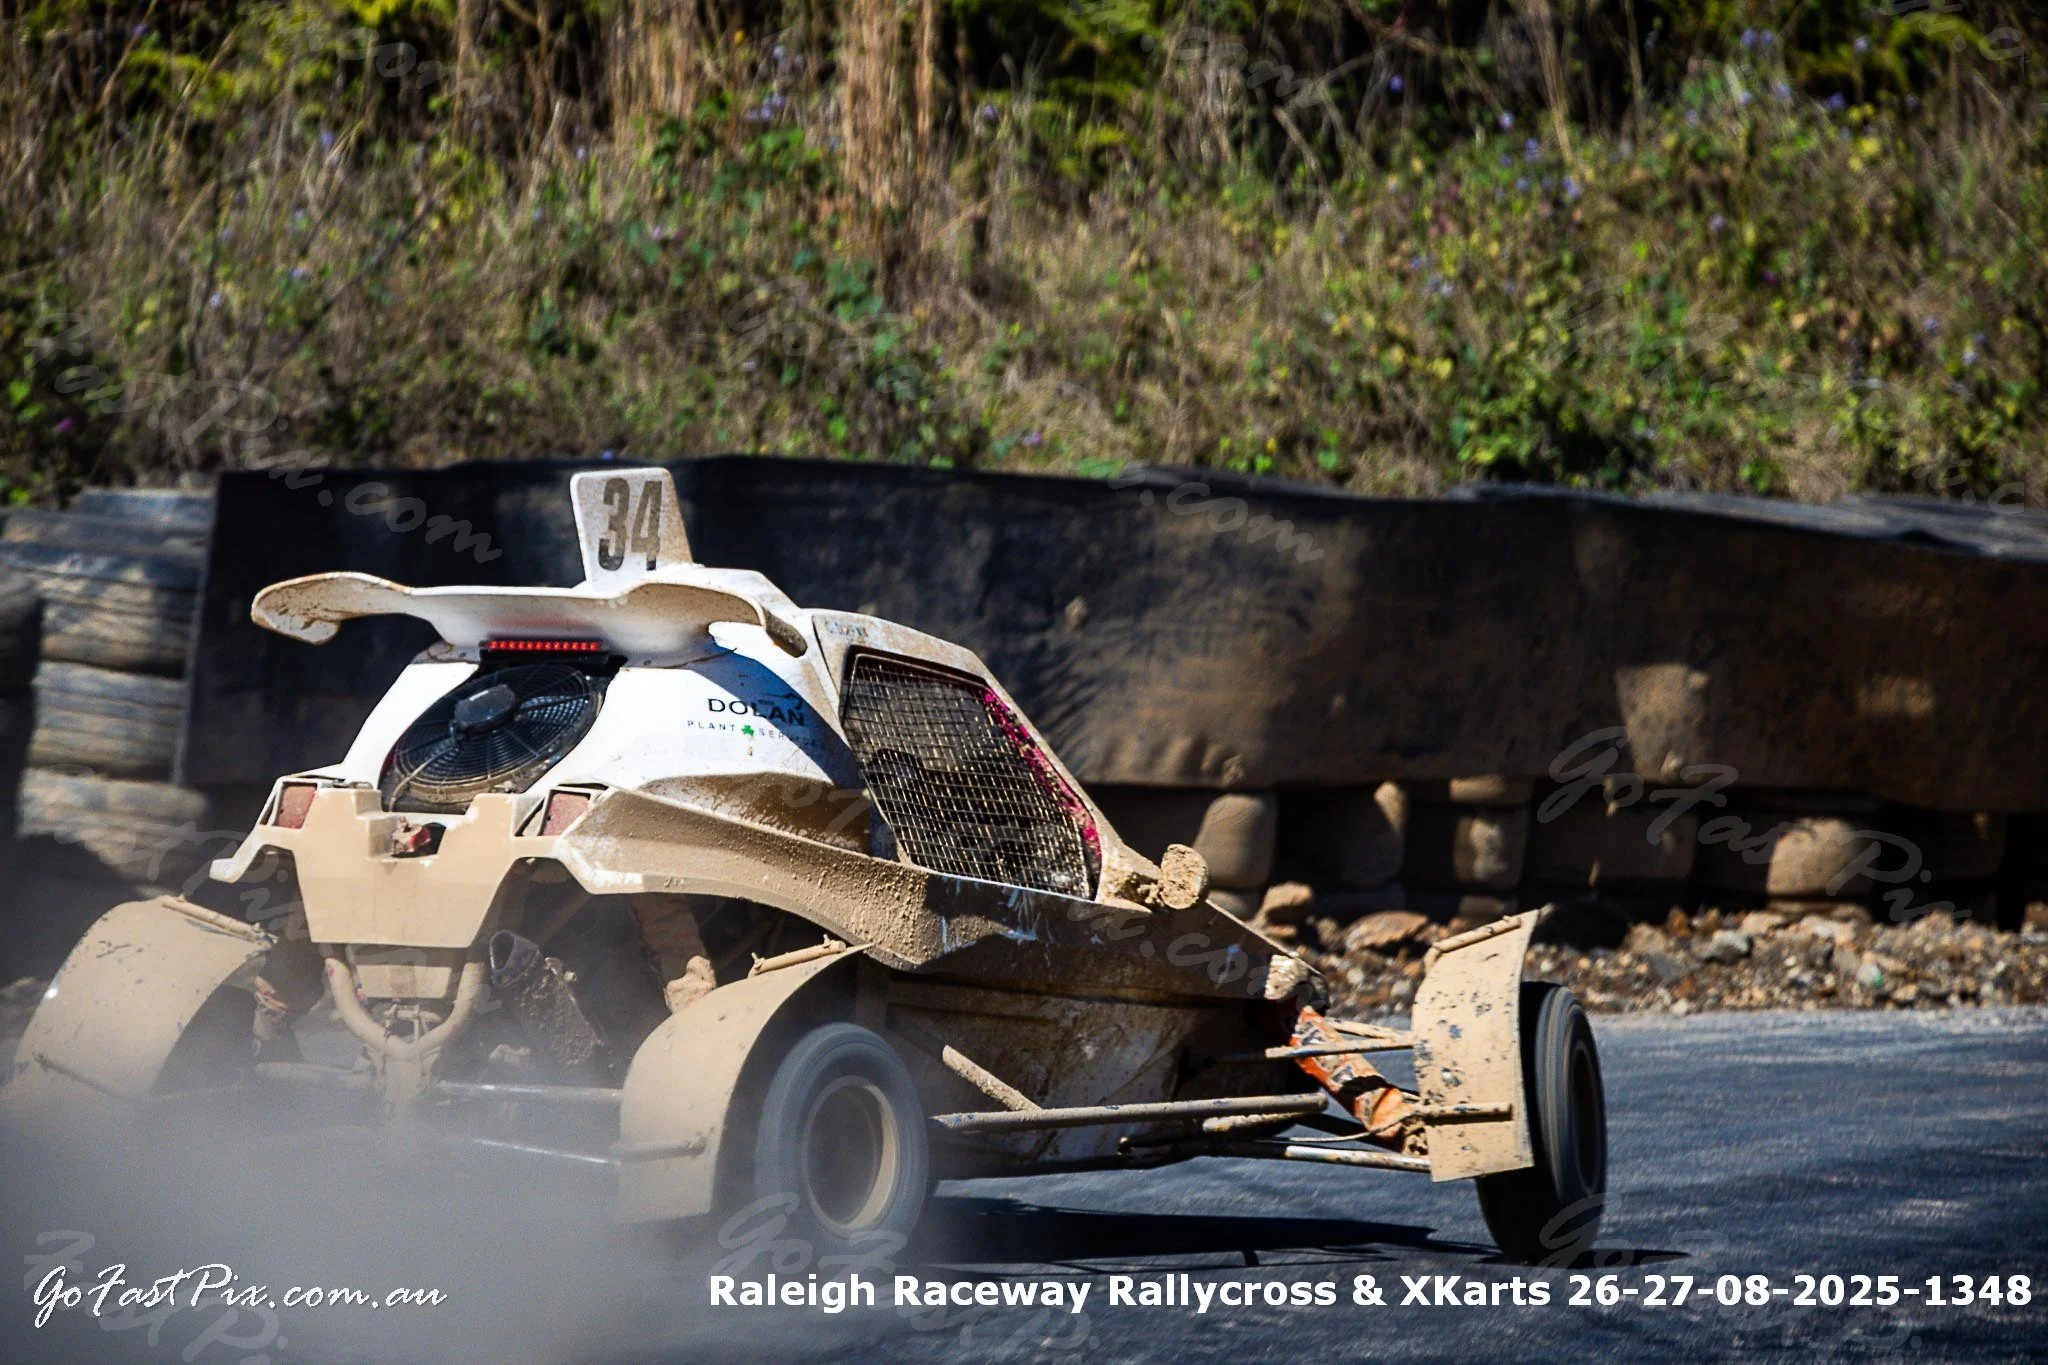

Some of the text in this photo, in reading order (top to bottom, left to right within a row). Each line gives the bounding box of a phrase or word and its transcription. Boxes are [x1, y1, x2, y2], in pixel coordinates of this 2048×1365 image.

[598, 477, 662, 571] 34
[687, 720, 736, 733] PLANT
[707, 698, 805, 727] DOLAN
